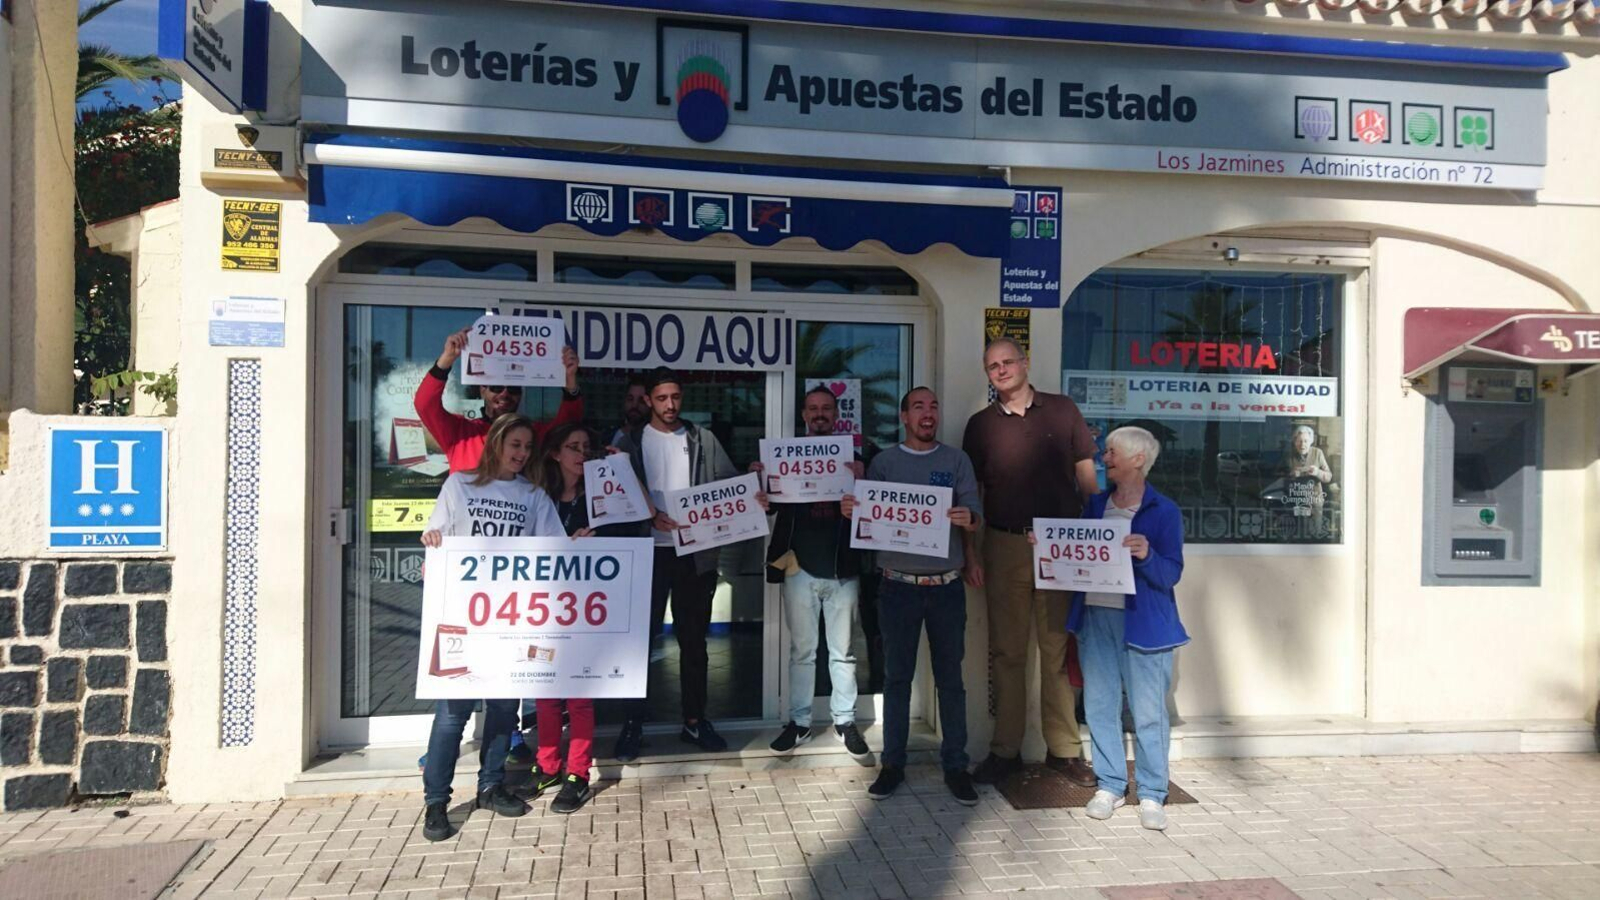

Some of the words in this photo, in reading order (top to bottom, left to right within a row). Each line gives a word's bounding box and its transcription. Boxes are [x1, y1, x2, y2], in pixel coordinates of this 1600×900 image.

[400, 35, 598, 88] Loterías
[613, 60, 641, 101] y
[764, 64, 963, 115] Apuestas
[981, 77, 1044, 117] del
[1058, 82, 1198, 123] Estado
[1157, 151, 1190, 170] Los
[1198, 153, 1285, 173] Jazmines
[1300, 157, 1439, 182] Administración
[1447, 165, 1466, 182] nº
[1473, 166, 1493, 184] 72
[225, 201, 279, 212] TECNY-GES
[1003, 267, 1039, 276] Loterías
[1041, 269, 1046, 278] y
[1003, 280, 1043, 291] Apuestas
[1045, 280, 1058, 290] del
[1003, 293, 1032, 302] Estado
[492, 324, 551, 338] PREMIO
[482, 339, 547, 357] 04536
[695, 315, 792, 369] AQUI
[1130, 340, 1277, 370] LOTERIA
[1128, 379, 1211, 393] LOTERIA
[1218, 381, 1242, 393] DE
[1248, 383, 1331, 396] NAVIDAD
[1190, 402, 1203, 410] a
[1211, 401, 1230, 410] la
[1238, 403, 1306, 413] venta!
[787, 444, 840, 457] PREMIO
[73, 439, 141, 494] H
[779, 459, 837, 476] 04536
[693, 484, 747, 505] PREMIO
[881, 490, 937, 506] PREMIO
[480, 498, 528, 512] PREMIO
[688, 499, 747, 524] 04536
[468, 508, 526, 523] VENDIDO
[872, 505, 932, 525] 04536
[81, 533, 130, 545] PLAYA
[1058, 527, 1115, 541] PREMIO
[1050, 543, 1110, 562] 04536
[491, 555, 620, 582] PREMIO
[467, 591, 608, 627] 04536
[446, 637, 464, 654] 22
